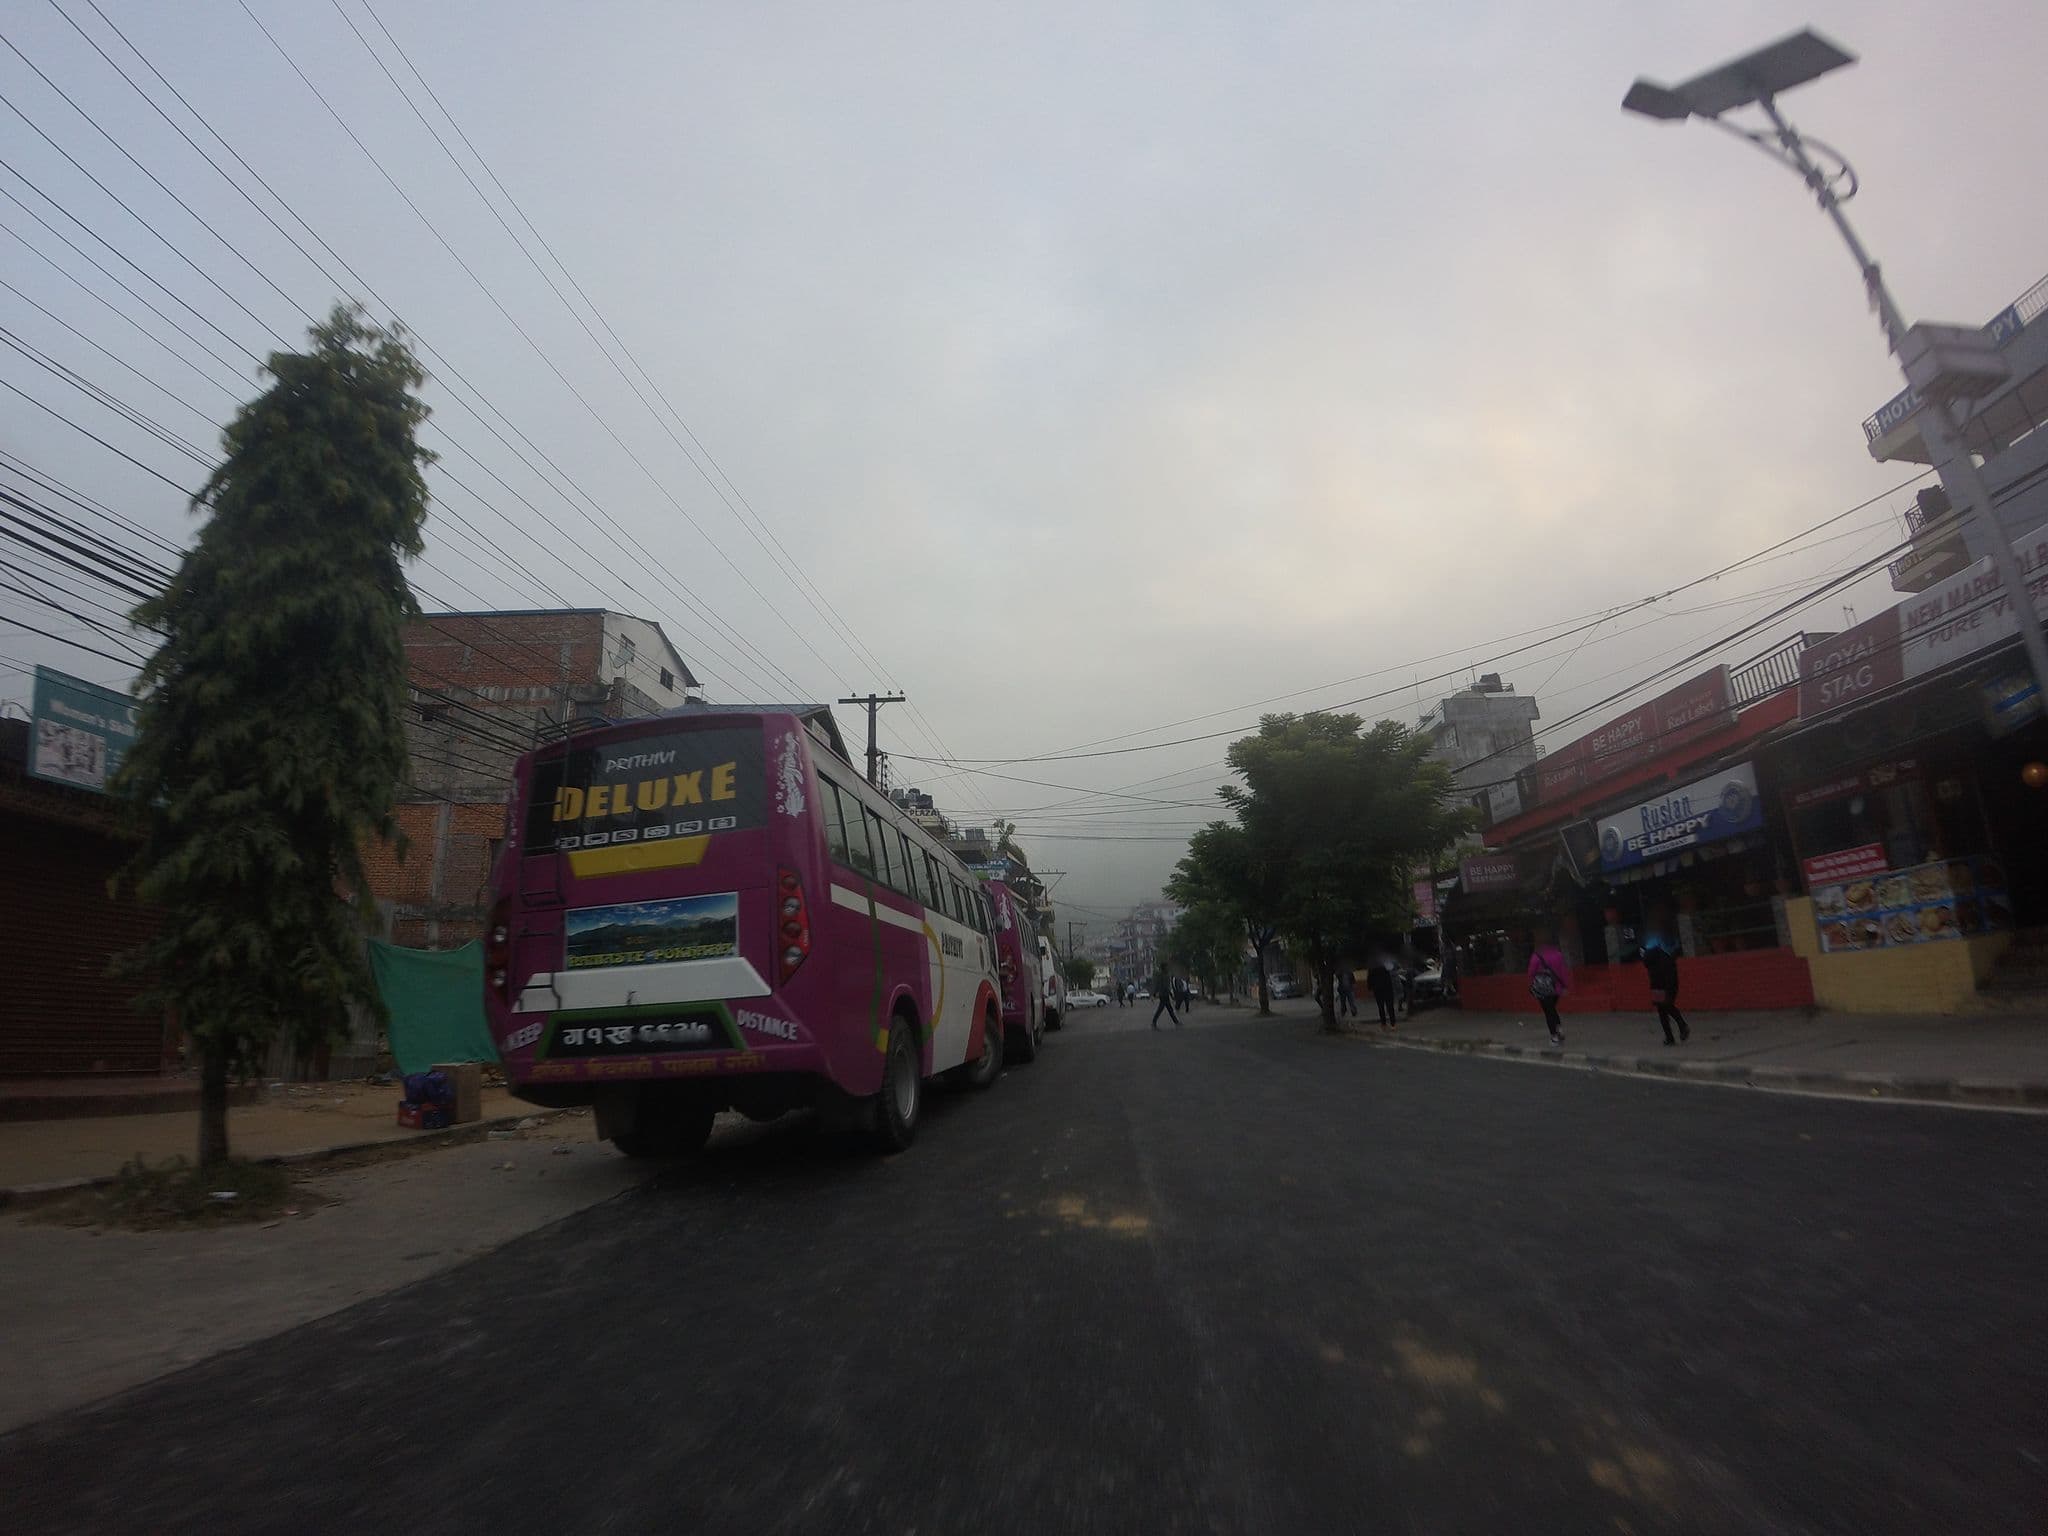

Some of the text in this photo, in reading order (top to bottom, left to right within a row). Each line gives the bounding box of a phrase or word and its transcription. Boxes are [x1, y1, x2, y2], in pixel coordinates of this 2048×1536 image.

[1991, 311, 2016, 342] PY
[1812, 634, 1877, 677] ROYAL
[1820, 664, 1874, 704] STAG
[1592, 716, 1642, 752] BE HAPPY
[605, 749, 677, 773] PRITHIVI
[552, 761, 737, 823] DELUXE
[1626, 813, 1712, 852] BE HAPPY
[1640, 794, 1694, 834] Ruslan
[1470, 862, 1514, 877] BE HAPPY
[736, 1008, 799, 1041] DISTANCE
